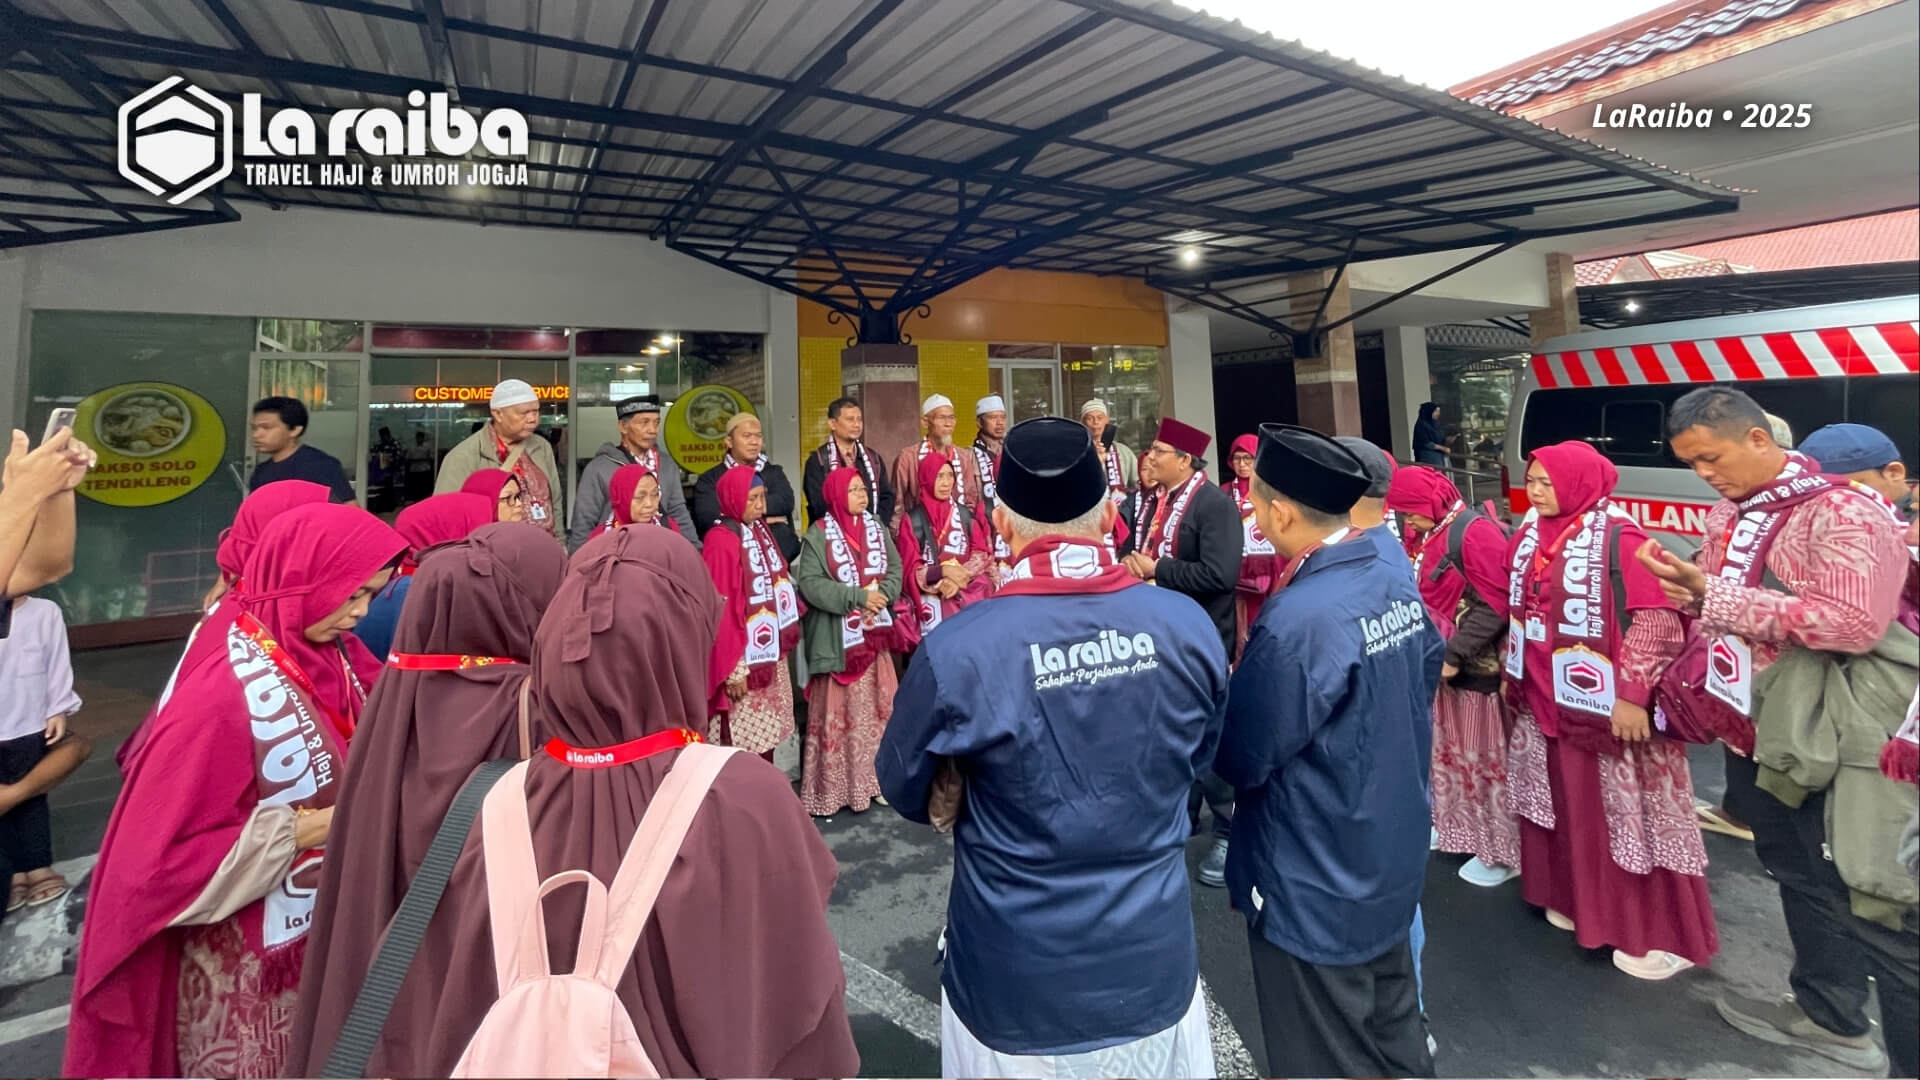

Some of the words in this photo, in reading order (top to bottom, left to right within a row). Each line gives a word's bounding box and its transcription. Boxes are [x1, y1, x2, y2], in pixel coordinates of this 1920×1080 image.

[149, 460, 196, 471] SOLO
[86, 475, 191, 490] TENGKLENG
[1588, 569, 1602, 603] Umroh
[1589, 616, 1604, 638] Haji
[1131, 657, 1159, 675] Anda
[313, 751, 334, 788] Haji
